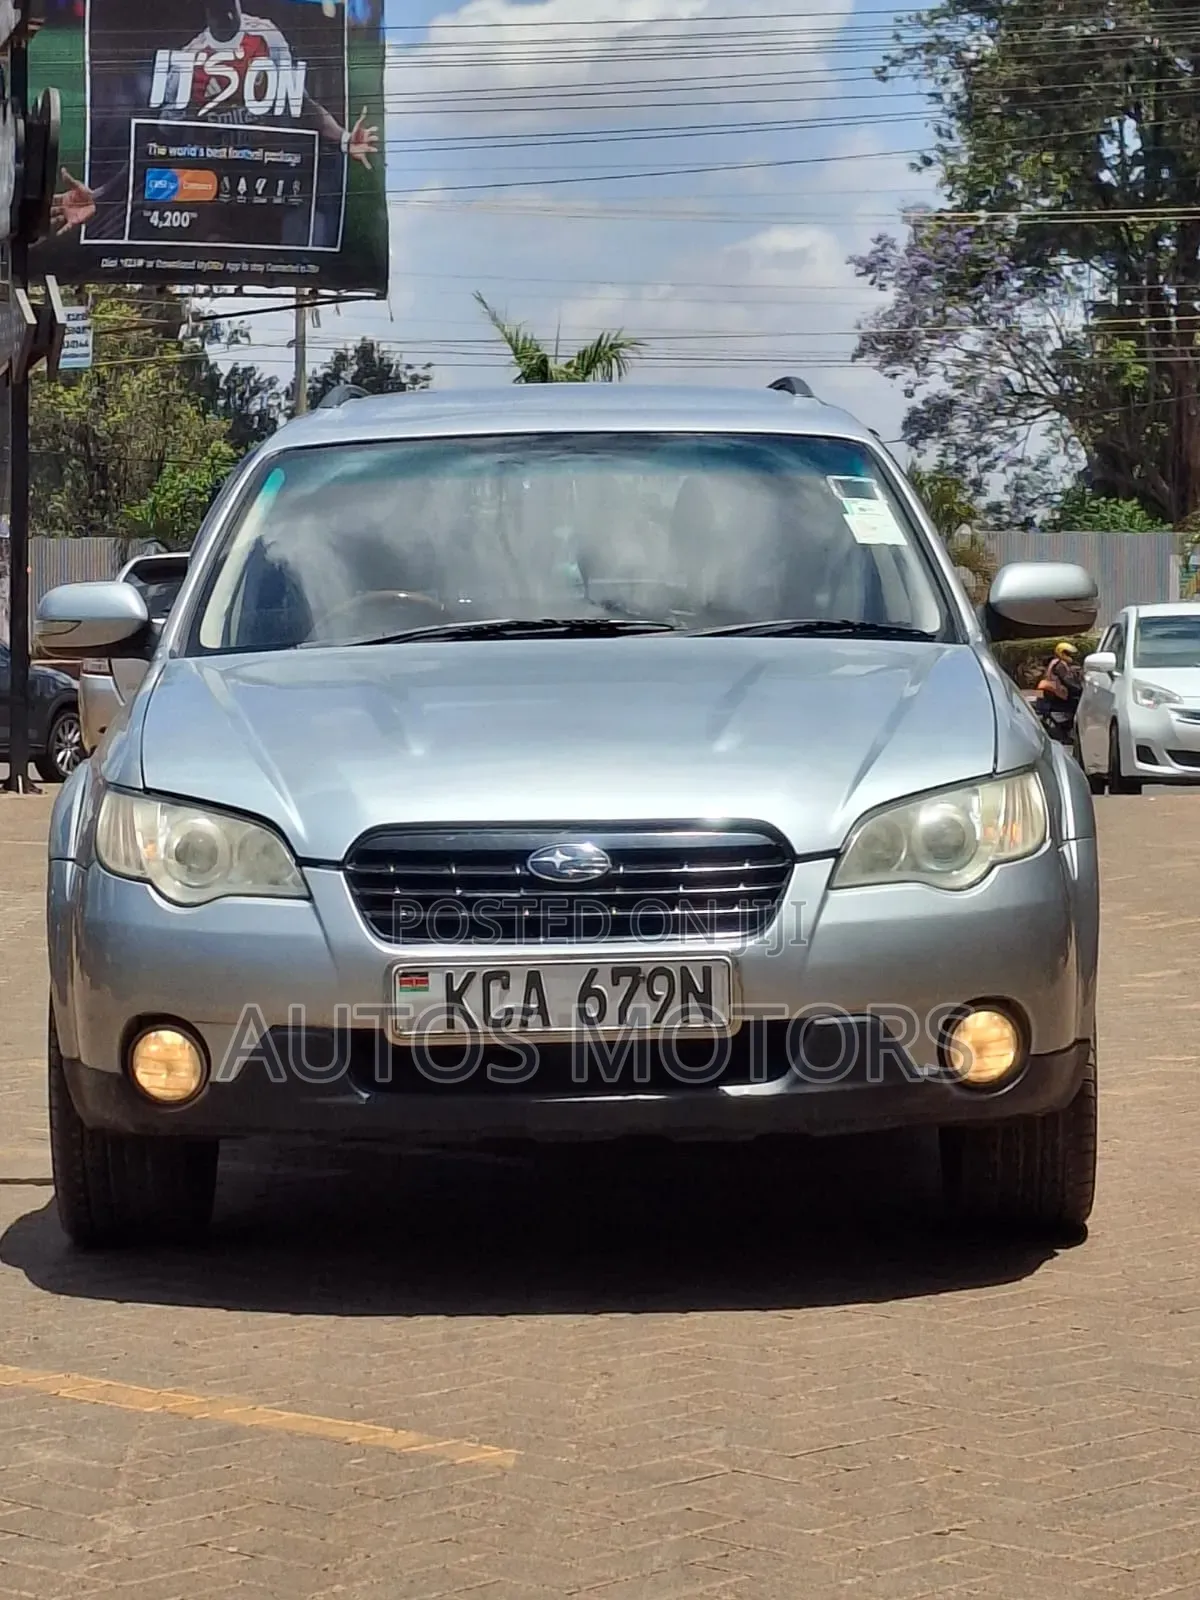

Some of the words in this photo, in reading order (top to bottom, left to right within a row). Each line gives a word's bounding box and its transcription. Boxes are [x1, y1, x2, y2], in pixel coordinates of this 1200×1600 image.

[244, 57, 307, 117] ON
[150, 211, 190, 228] 4,200
[444, 969, 553, 1030] KCA
[576, 965, 713, 1026] 679N
